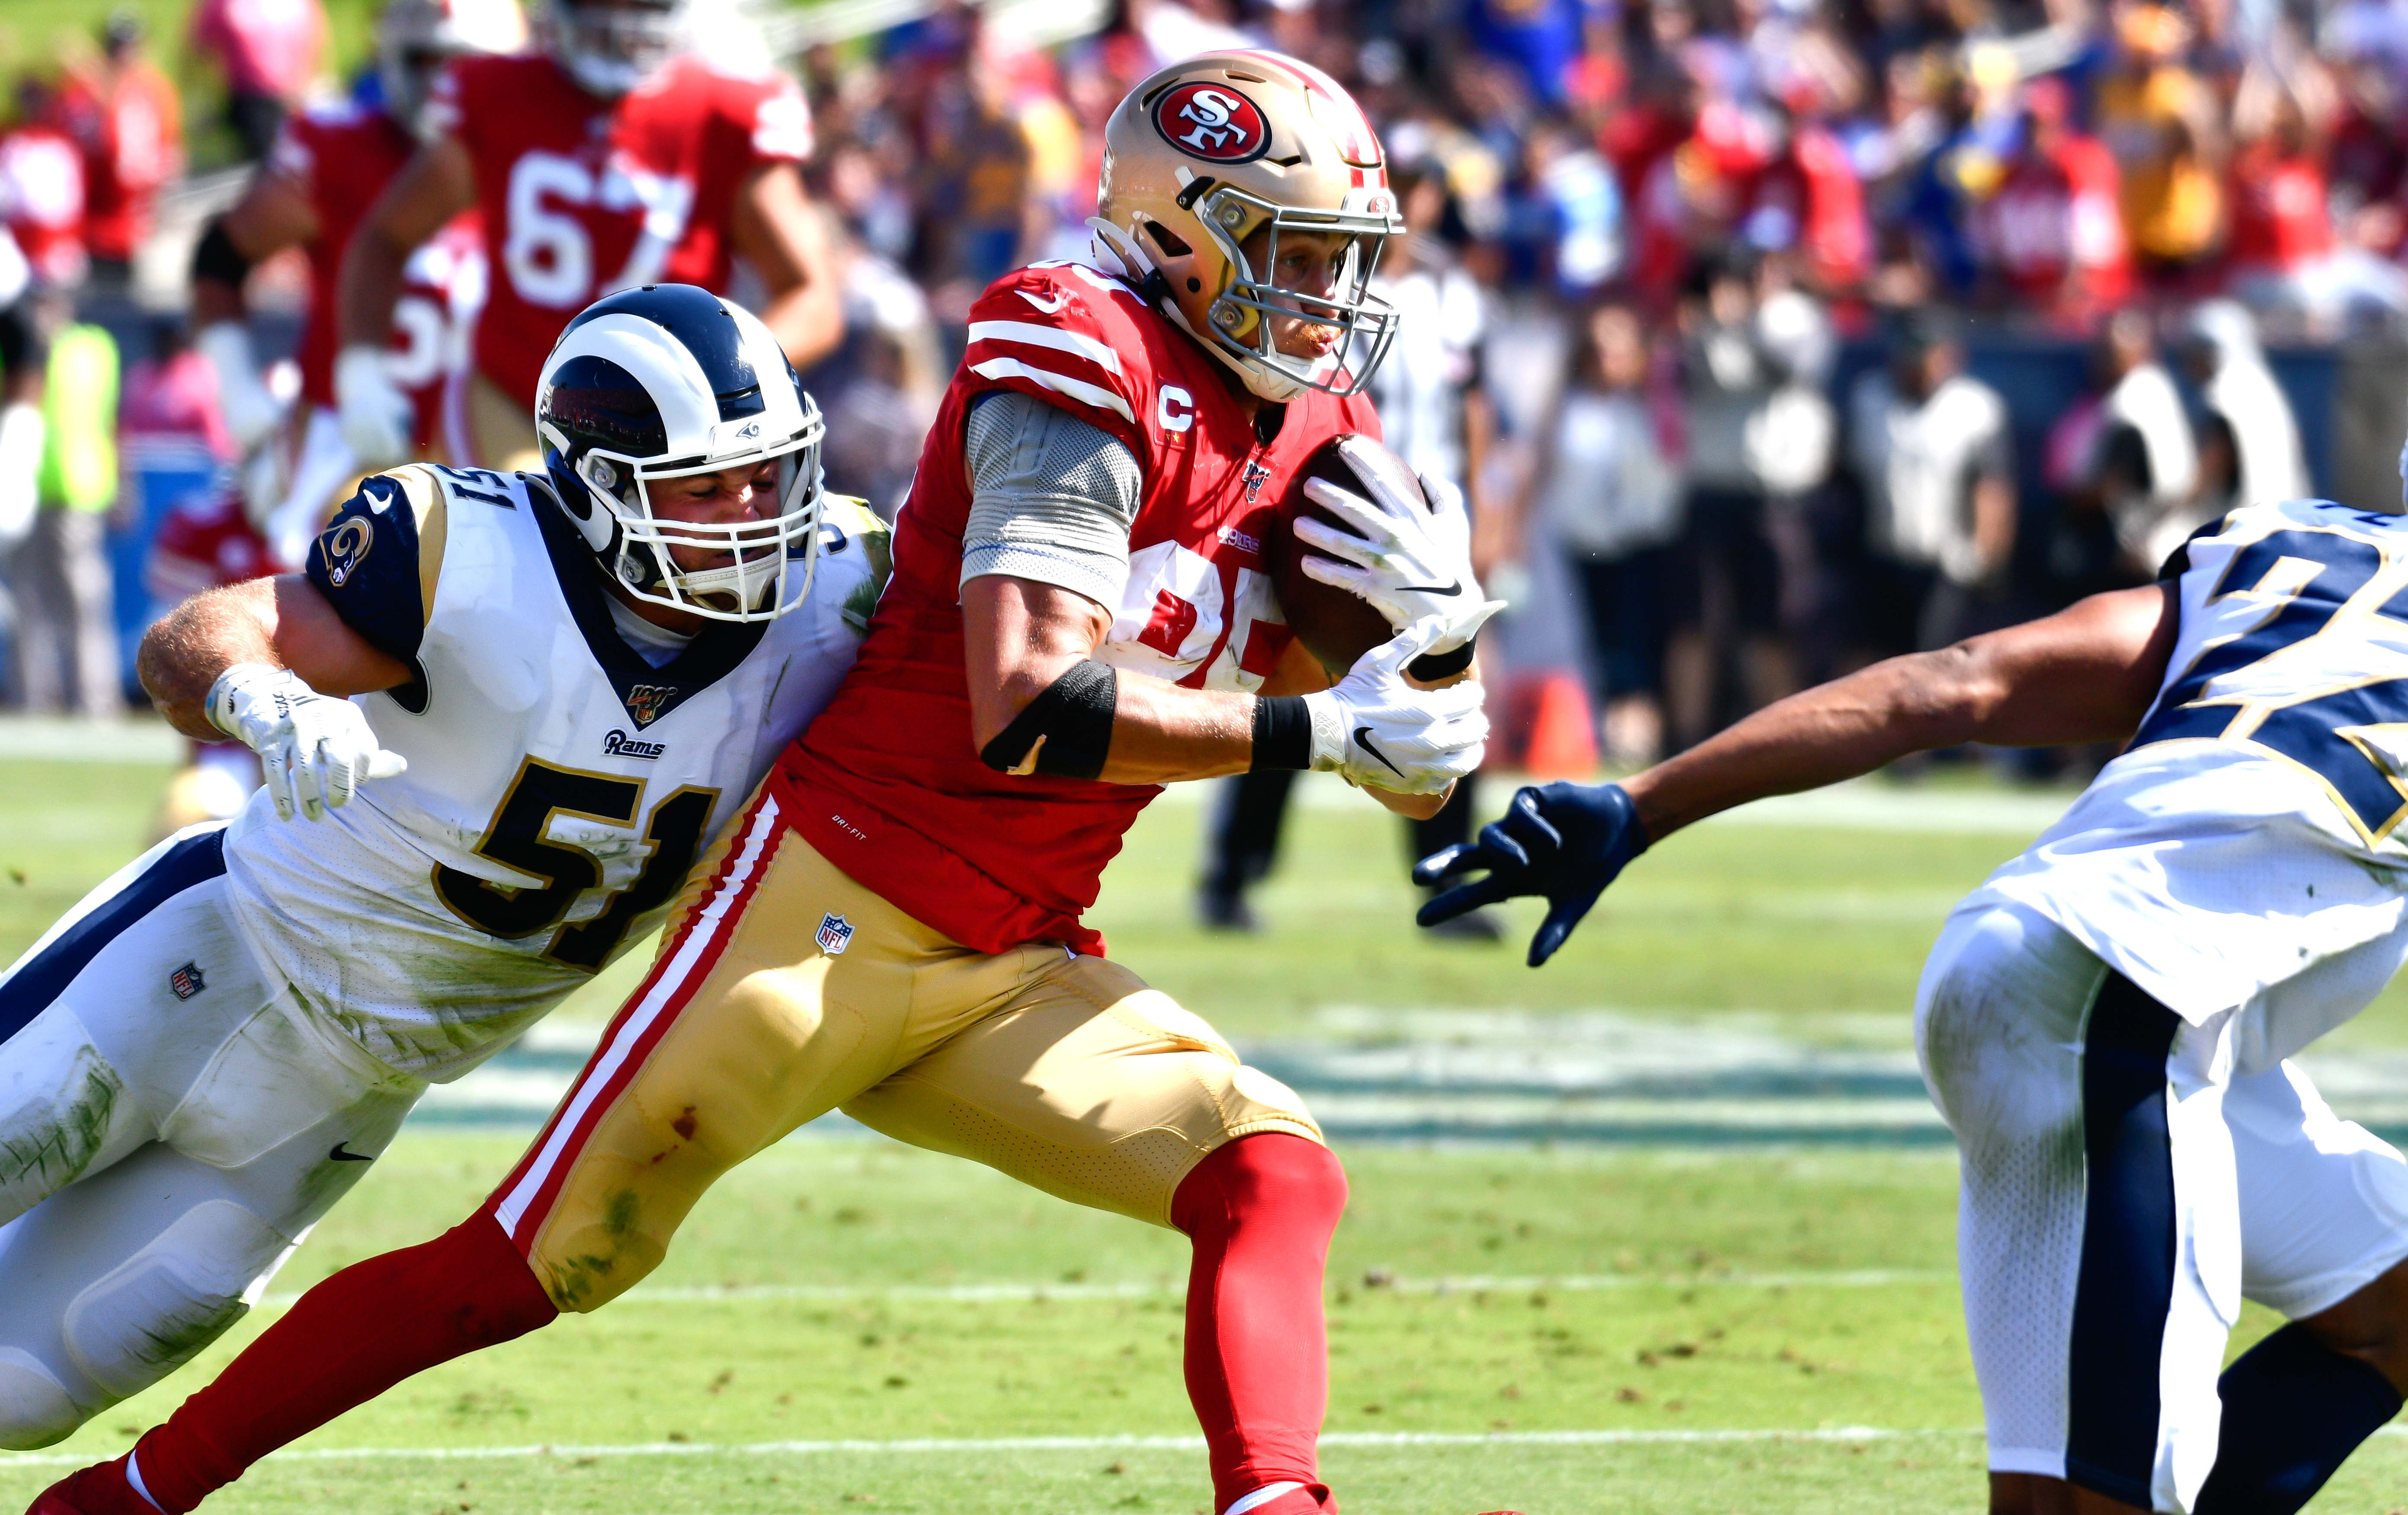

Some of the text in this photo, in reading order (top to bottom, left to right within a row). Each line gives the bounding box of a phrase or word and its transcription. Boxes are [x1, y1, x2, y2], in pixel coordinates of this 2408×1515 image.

[504, 148, 694, 309] 67
[1158, 384, 1193, 432] C
[434, 463, 518, 511] 51
[638, 708, 652, 719] NFL
[604, 729, 666, 759] Rams
[832, 814, 866, 840] DRI-FIT
[430, 753, 722, 975] 51
[820, 927, 842, 949] NFL
[173, 971, 192, 996] NFL
